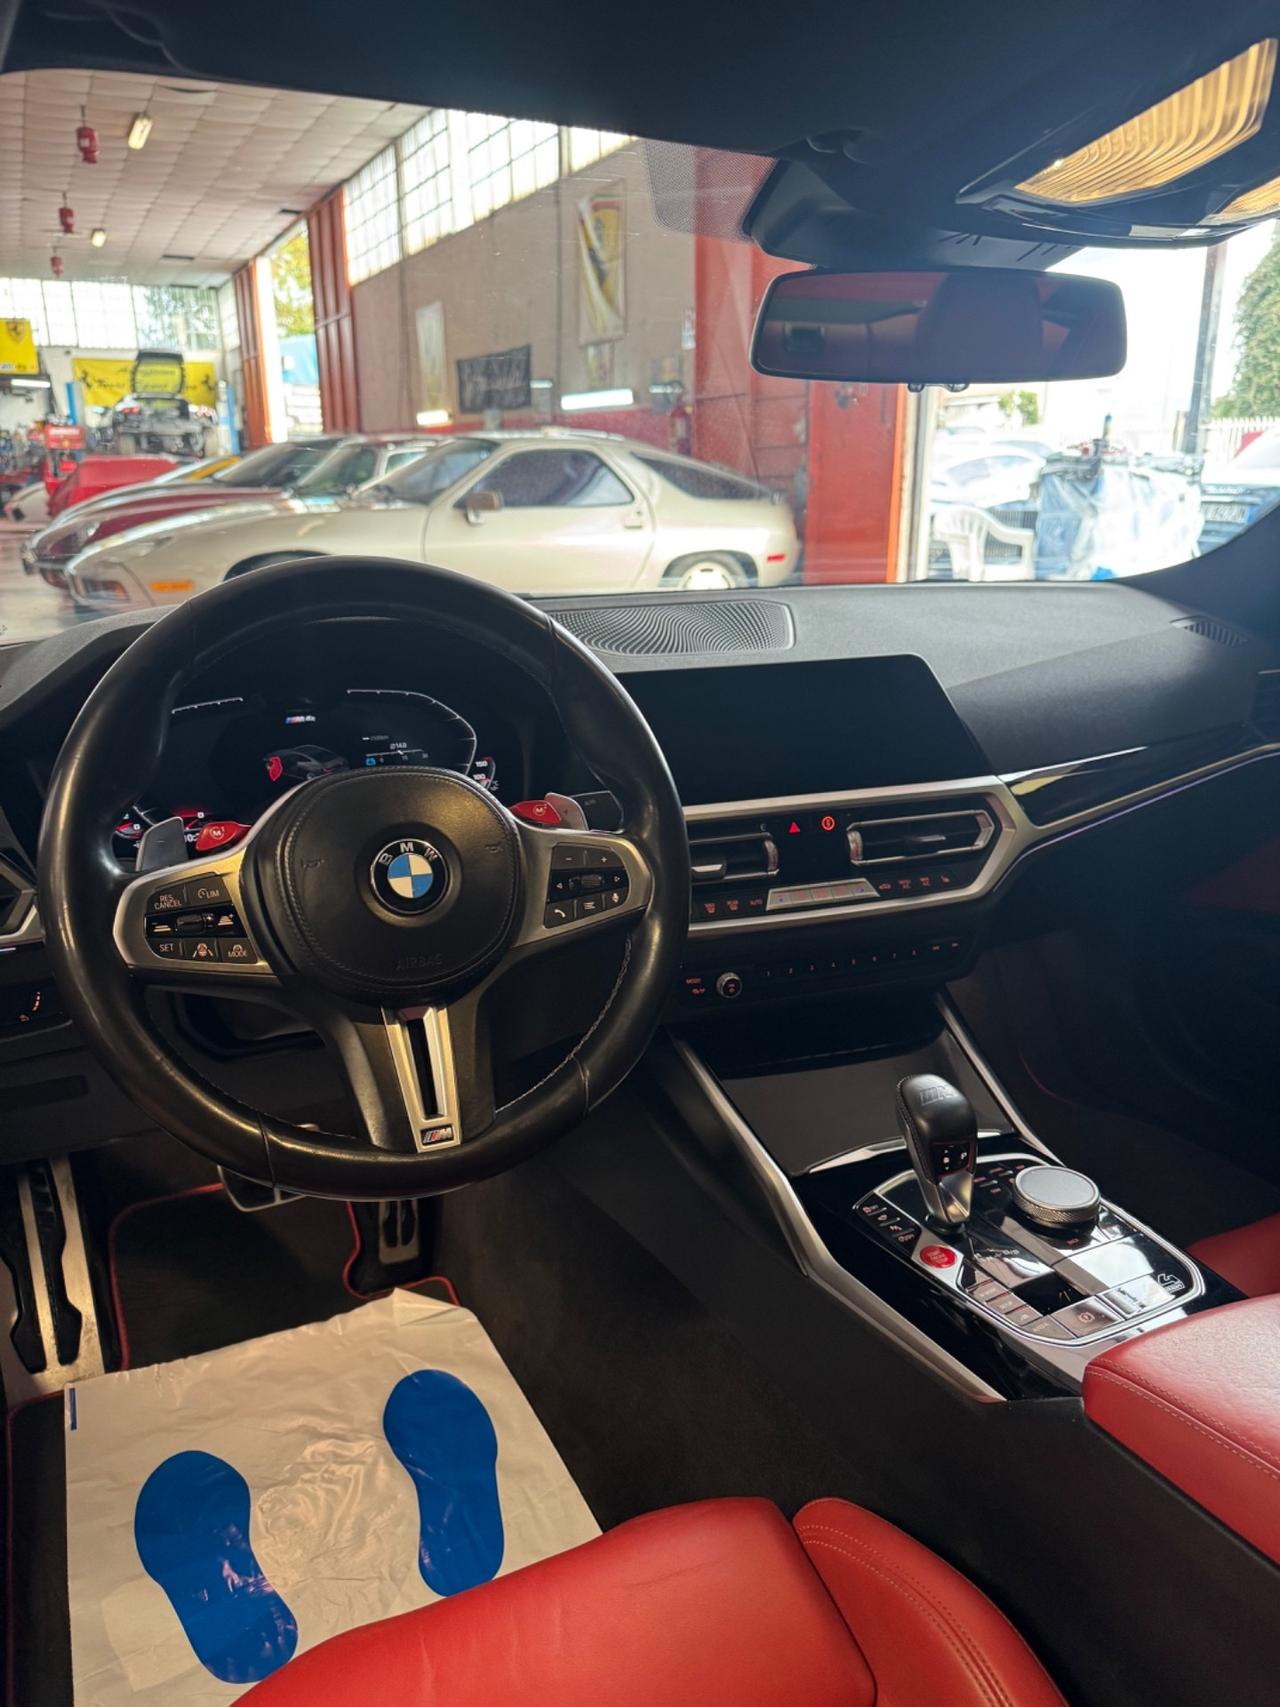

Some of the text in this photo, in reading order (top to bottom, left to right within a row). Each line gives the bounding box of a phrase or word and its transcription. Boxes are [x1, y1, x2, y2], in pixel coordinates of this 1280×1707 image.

[379, 842, 438, 865] BMW
[154, 900, 182, 910] CANCEL
[160, 944, 174, 952] SET
